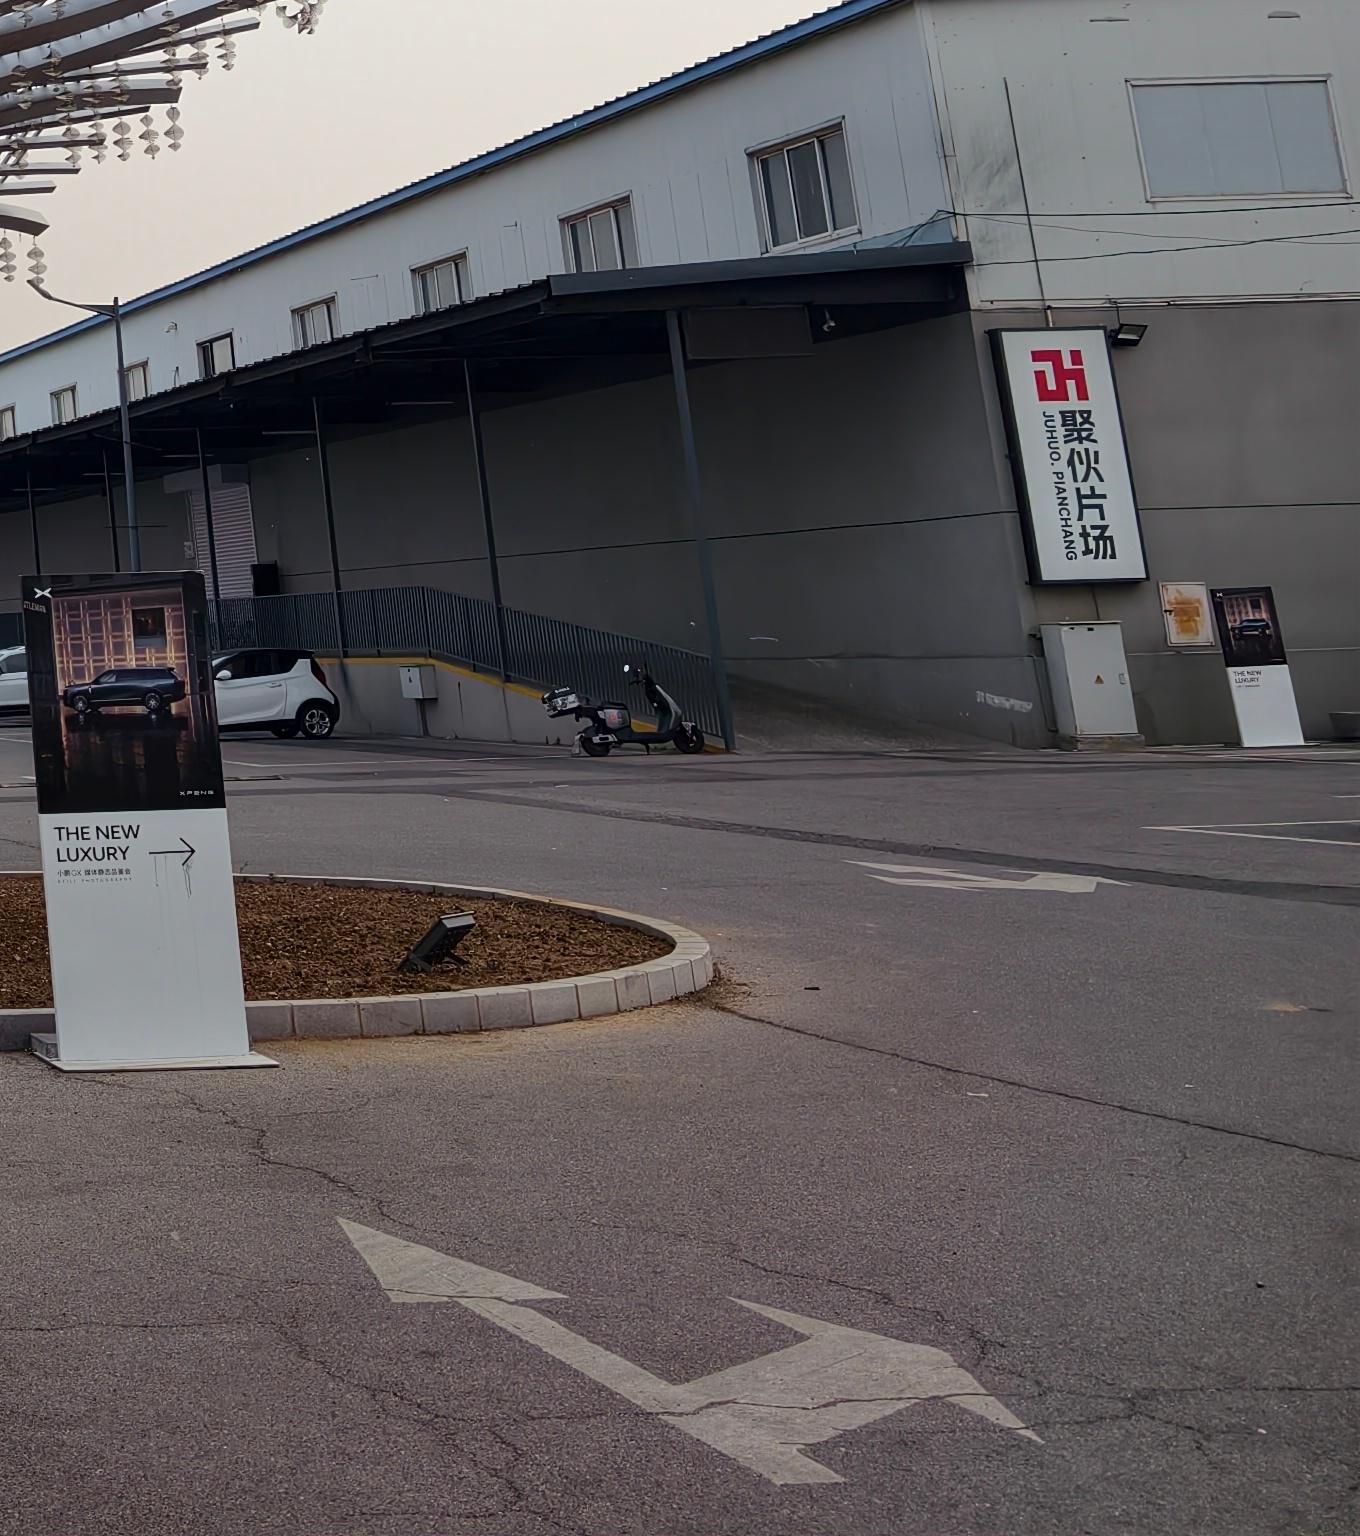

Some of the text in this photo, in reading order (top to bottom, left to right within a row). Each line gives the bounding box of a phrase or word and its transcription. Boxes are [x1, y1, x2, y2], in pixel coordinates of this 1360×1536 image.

[1042, 411, 1077, 561] JUHUO. PIANCHANG
[1059, 409, 1117, 560] 聚伙片场
[53, 824, 140, 841] THE NEW
[56, 845, 130, 862] LUXURY
